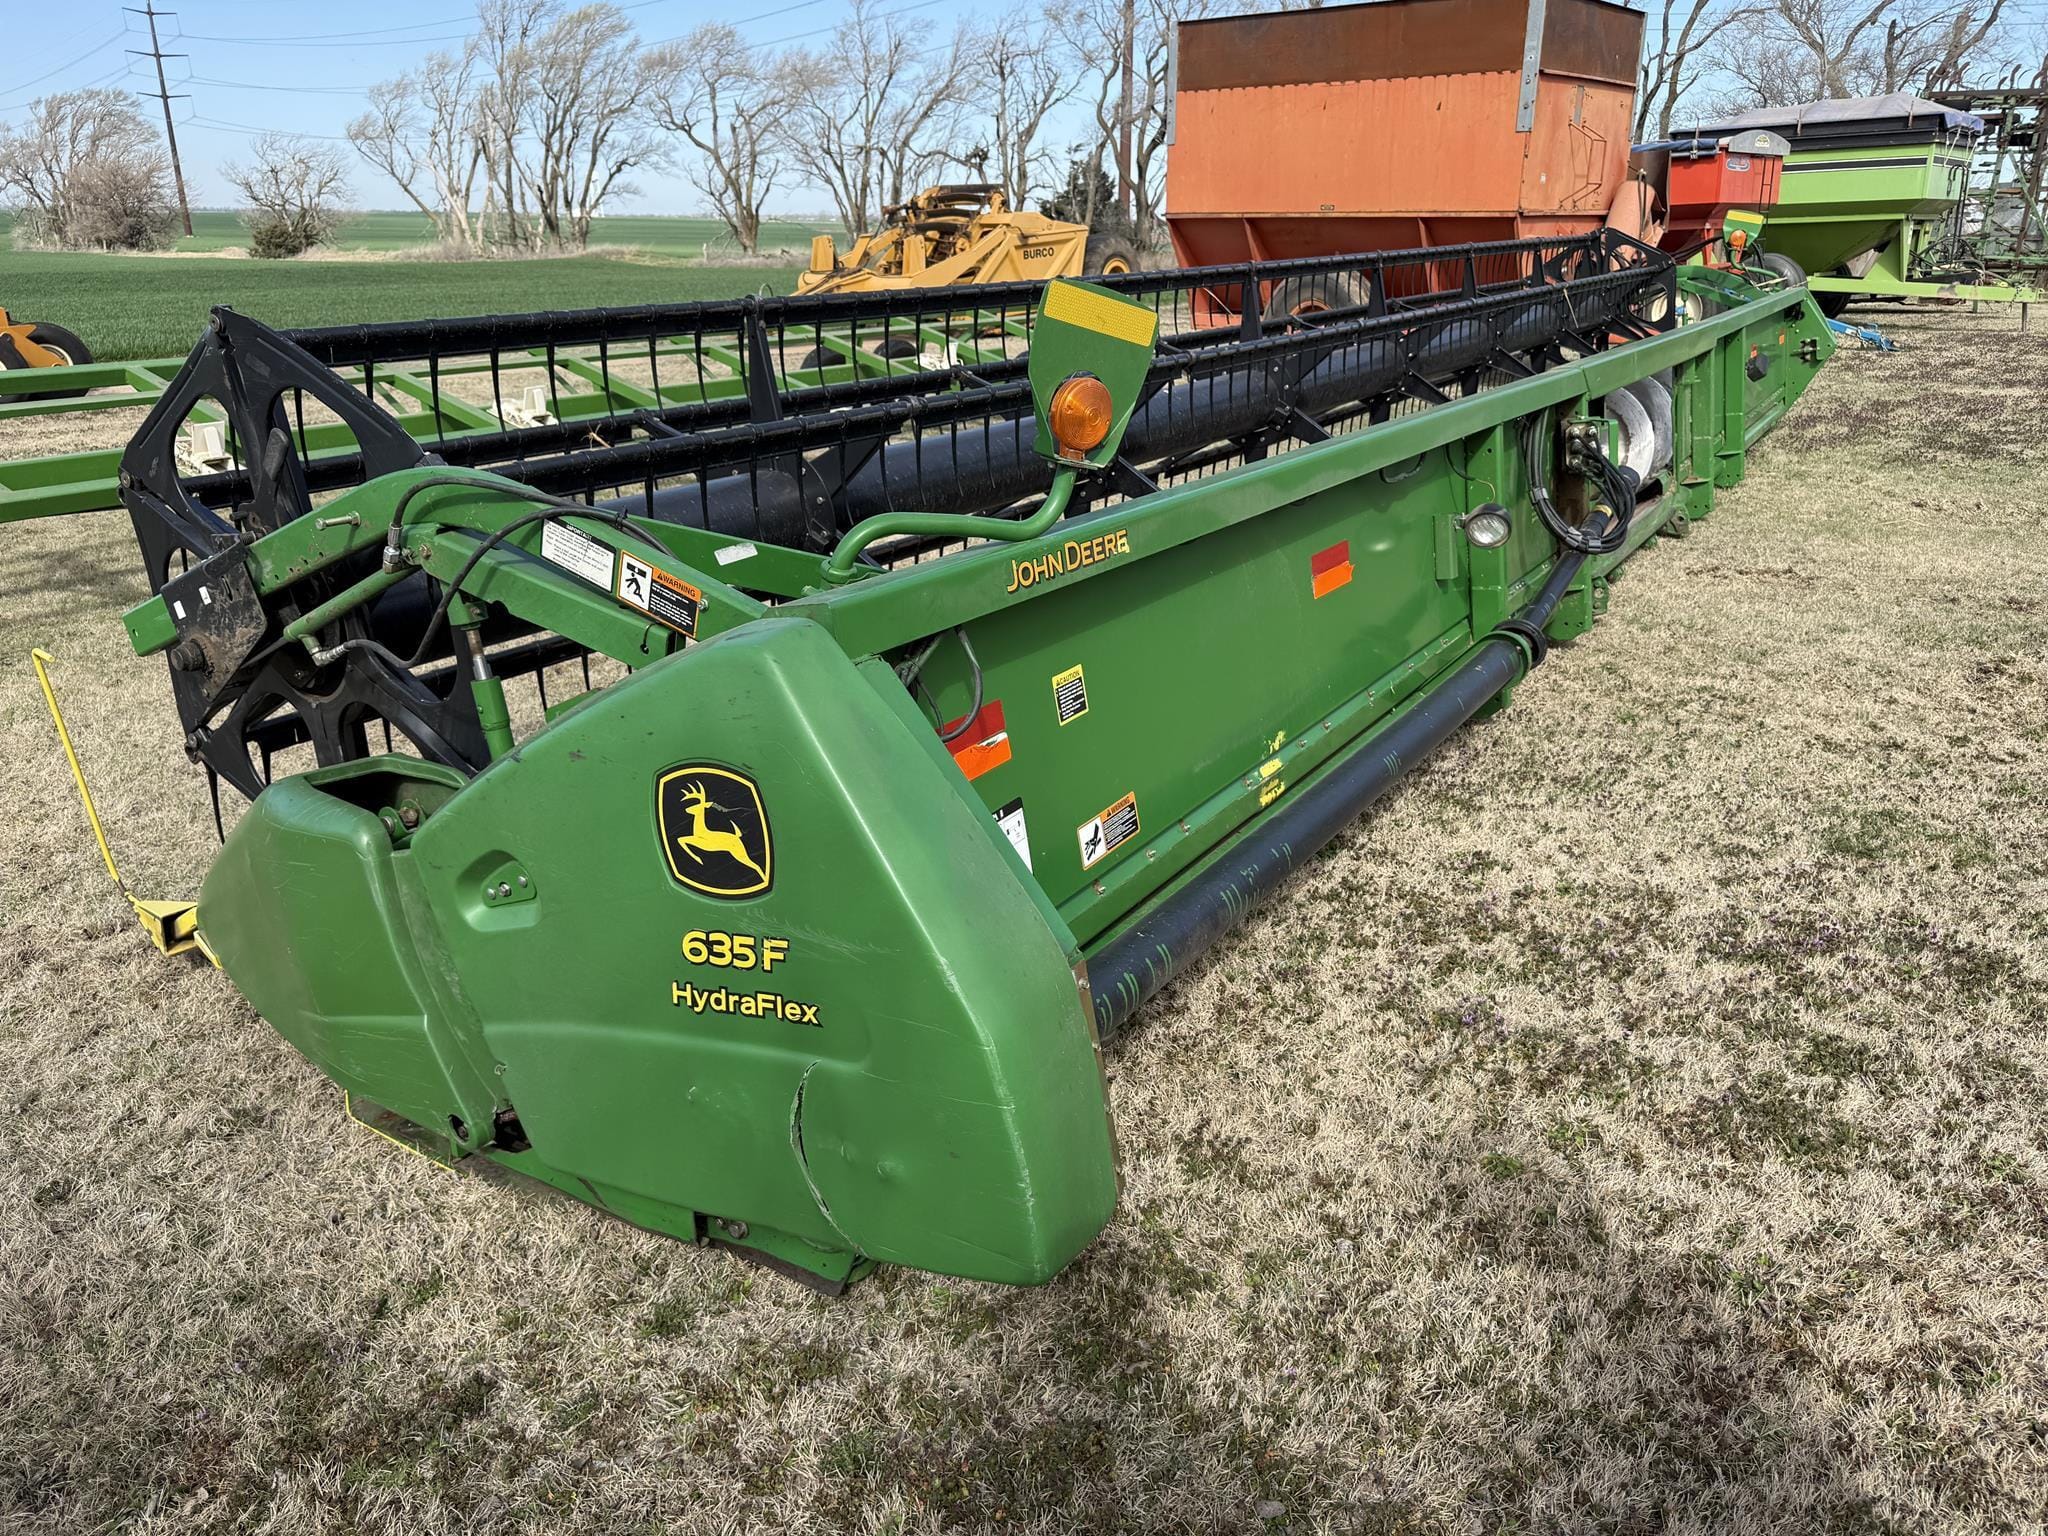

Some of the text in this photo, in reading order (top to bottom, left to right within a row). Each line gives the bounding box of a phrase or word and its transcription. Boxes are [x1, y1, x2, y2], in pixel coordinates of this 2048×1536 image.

[1023, 247, 1054, 260] BURCO
[1006, 529, 1130, 594] JOHN DEERE
[661, 573, 697, 598] WARNING
[1059, 670, 1080, 684] CAUTION
[671, 979, 824, 1028] HydraFlex
